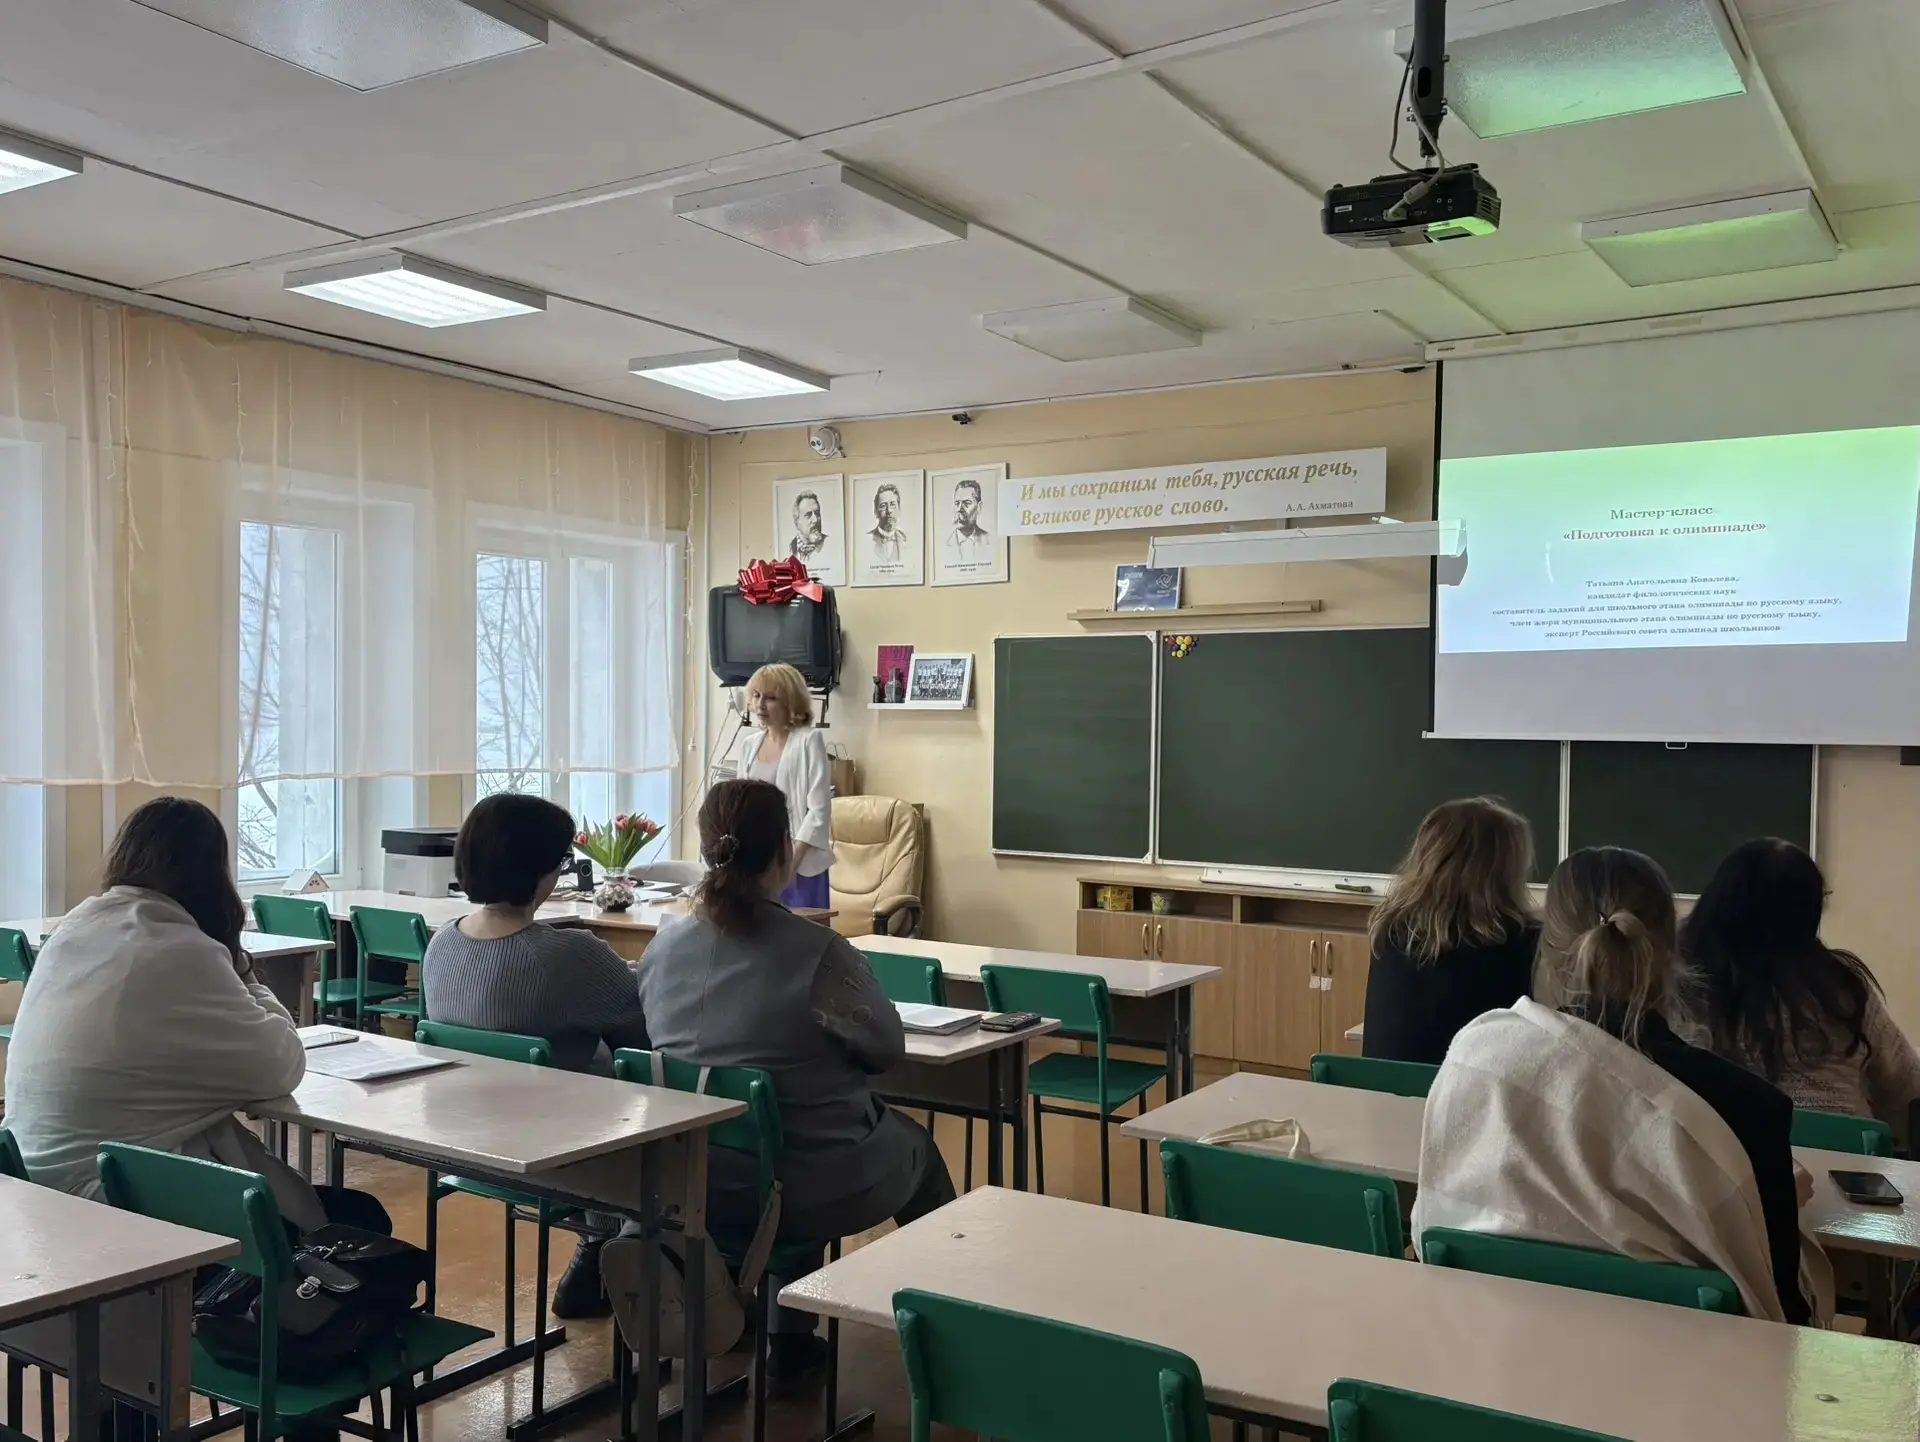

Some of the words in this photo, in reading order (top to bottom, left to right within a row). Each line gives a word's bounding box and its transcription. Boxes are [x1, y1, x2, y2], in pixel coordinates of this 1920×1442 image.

[1021, 484, 1035, 500] И
[1038, 485, 1065, 500] мы
[1070, 478, 1157, 499] сохраним
[1165, 468, 1218, 489] тебя,
[1221, 465, 1300, 490] русская
[1303, 462, 1357, 483] речь,
[1021, 508, 1090, 526] Великое
[1093, 503, 1163, 525] русское
[1170, 499, 1229, 516] слово.
[1308, 501, 1353, 510] Ахматова
[1610, 506, 1713, 520] Мастер-класс
[1563, 528, 1655, 541] «Подготовка
[1659, 528, 1669, 536] к
[1673, 522, 1766, 535] олимпиаде»
[1586, 579, 1624, 587] Татьяна
[1626, 578, 1687, 586] Анатольевна
[1587, 592, 1631, 600] кандидат
[1632, 589, 1710, 599] филологических
[1713, 588, 1736, 596] наук
[1588, 605, 1605, 613] для
[1658, 602, 1686, 610] этапа
[1688, 601, 1743, 609] олимпиады
[1760, 598, 1805, 607] русскому
[1562, 616, 1638, 626] муниципального
[1669, 614, 1724, 622] олимпиады
[1740, 612, 1786, 621] русскому
[1545, 630, 1580, 638] эксперт
[1582, 628, 1636, 636] Российского
